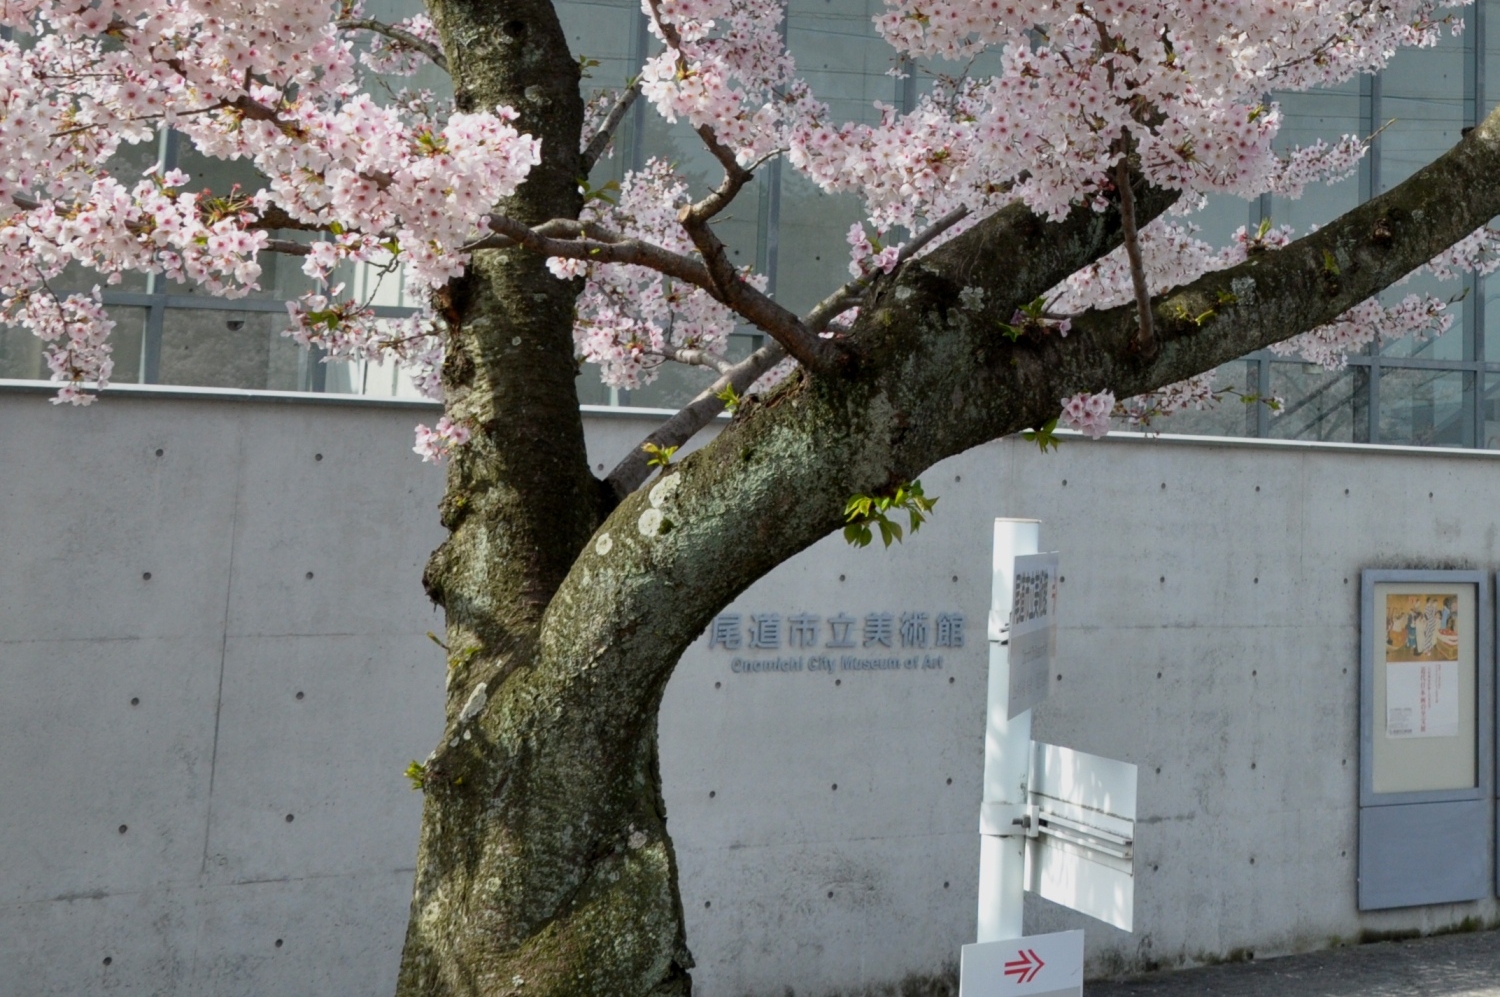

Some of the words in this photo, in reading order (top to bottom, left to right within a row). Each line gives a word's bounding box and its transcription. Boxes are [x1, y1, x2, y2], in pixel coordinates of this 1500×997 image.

[708, 611, 966, 651] 尾道市立美術館
[731, 656, 803, 673] Onomichi
[808, 656, 836, 675] City
[841, 655, 900, 671] Museum
[904, 655, 919, 670] of
[921, 653, 944, 670] Art
